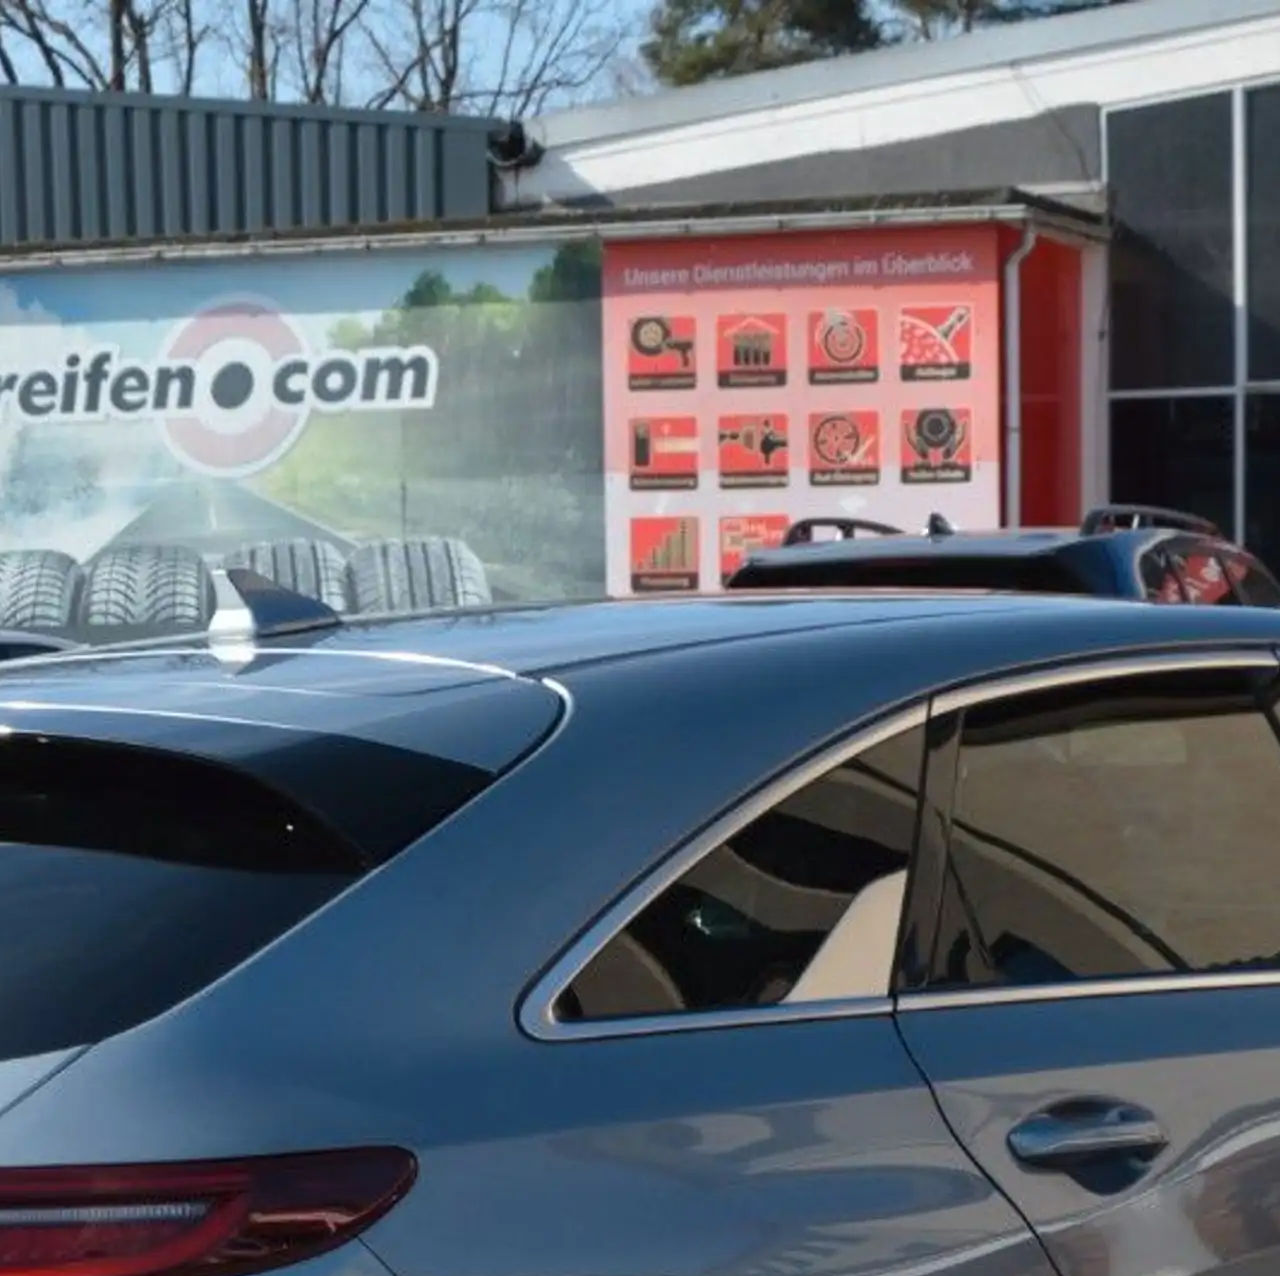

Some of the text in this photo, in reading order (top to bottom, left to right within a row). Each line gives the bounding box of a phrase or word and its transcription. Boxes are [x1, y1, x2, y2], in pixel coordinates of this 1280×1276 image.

[624, 250, 973, 286] Unsere Dienstleistungen im Überblick
